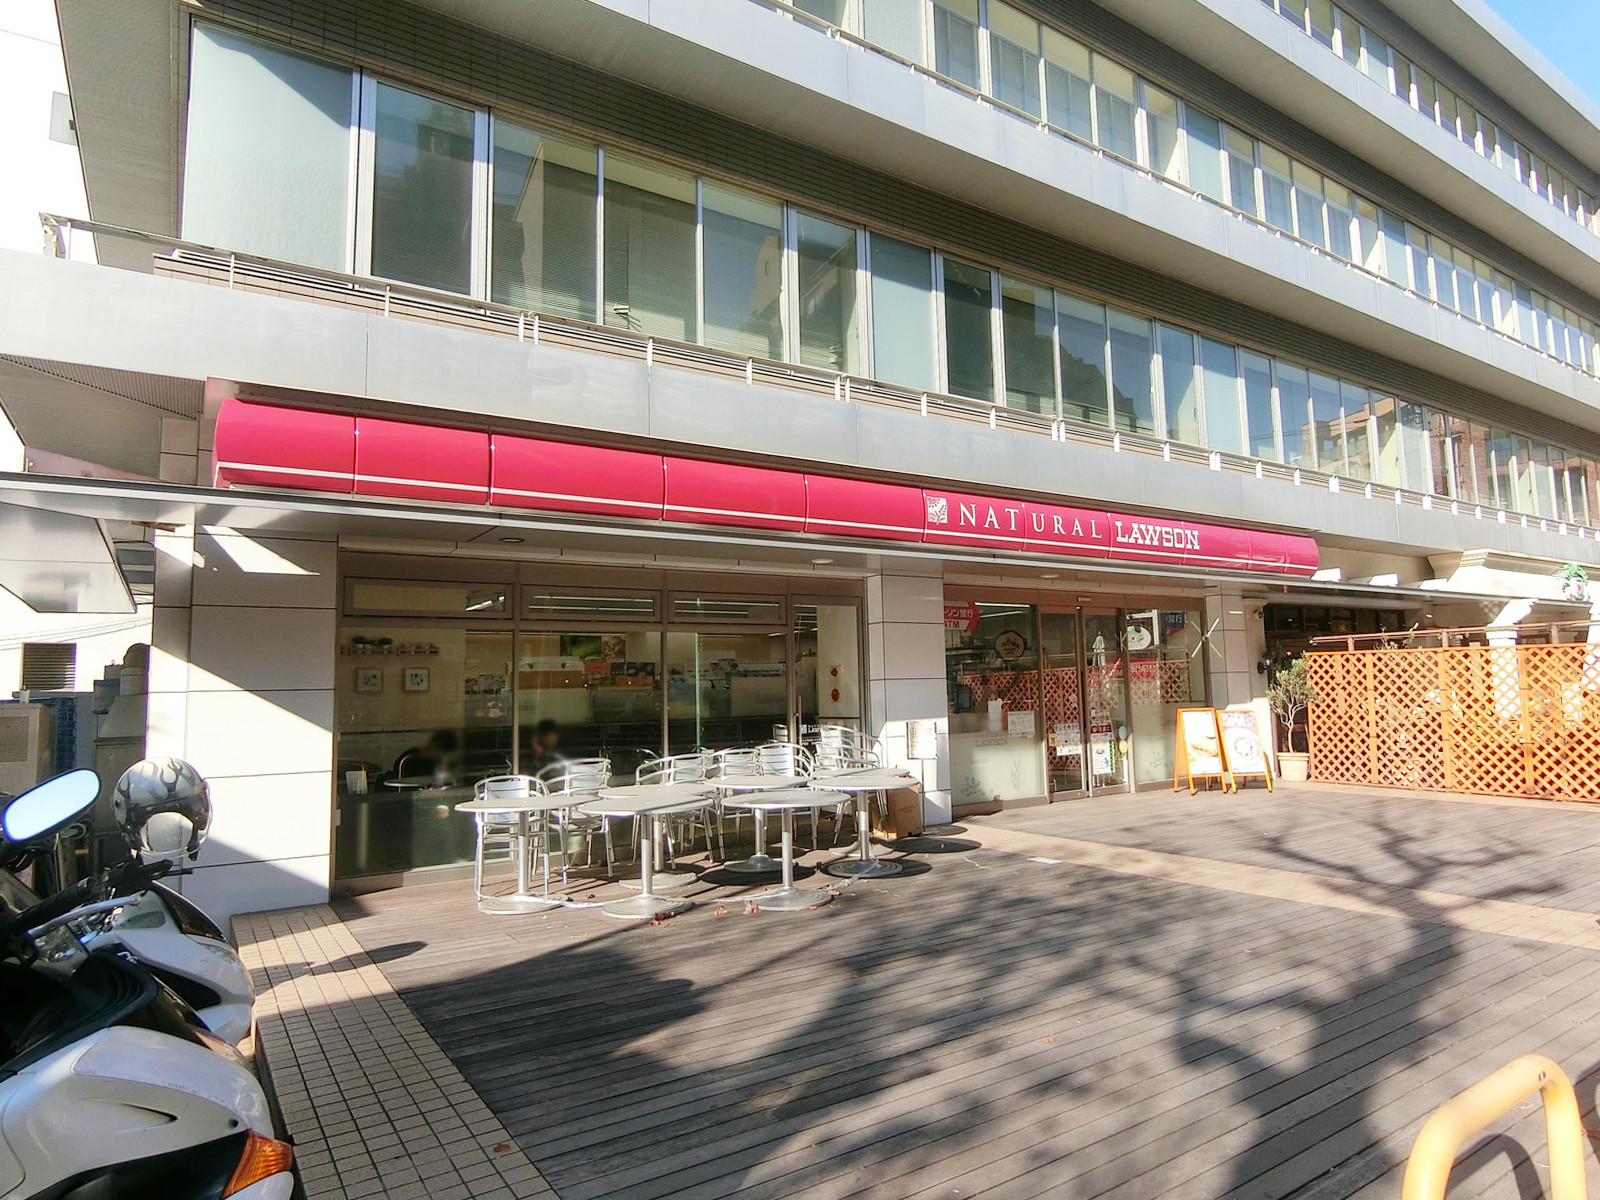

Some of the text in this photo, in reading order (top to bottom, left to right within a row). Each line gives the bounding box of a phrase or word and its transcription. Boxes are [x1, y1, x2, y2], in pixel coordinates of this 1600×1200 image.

[958, 501, 1201, 550] NATURAL LAWSON
[944, 620, 960, 629] ATM
